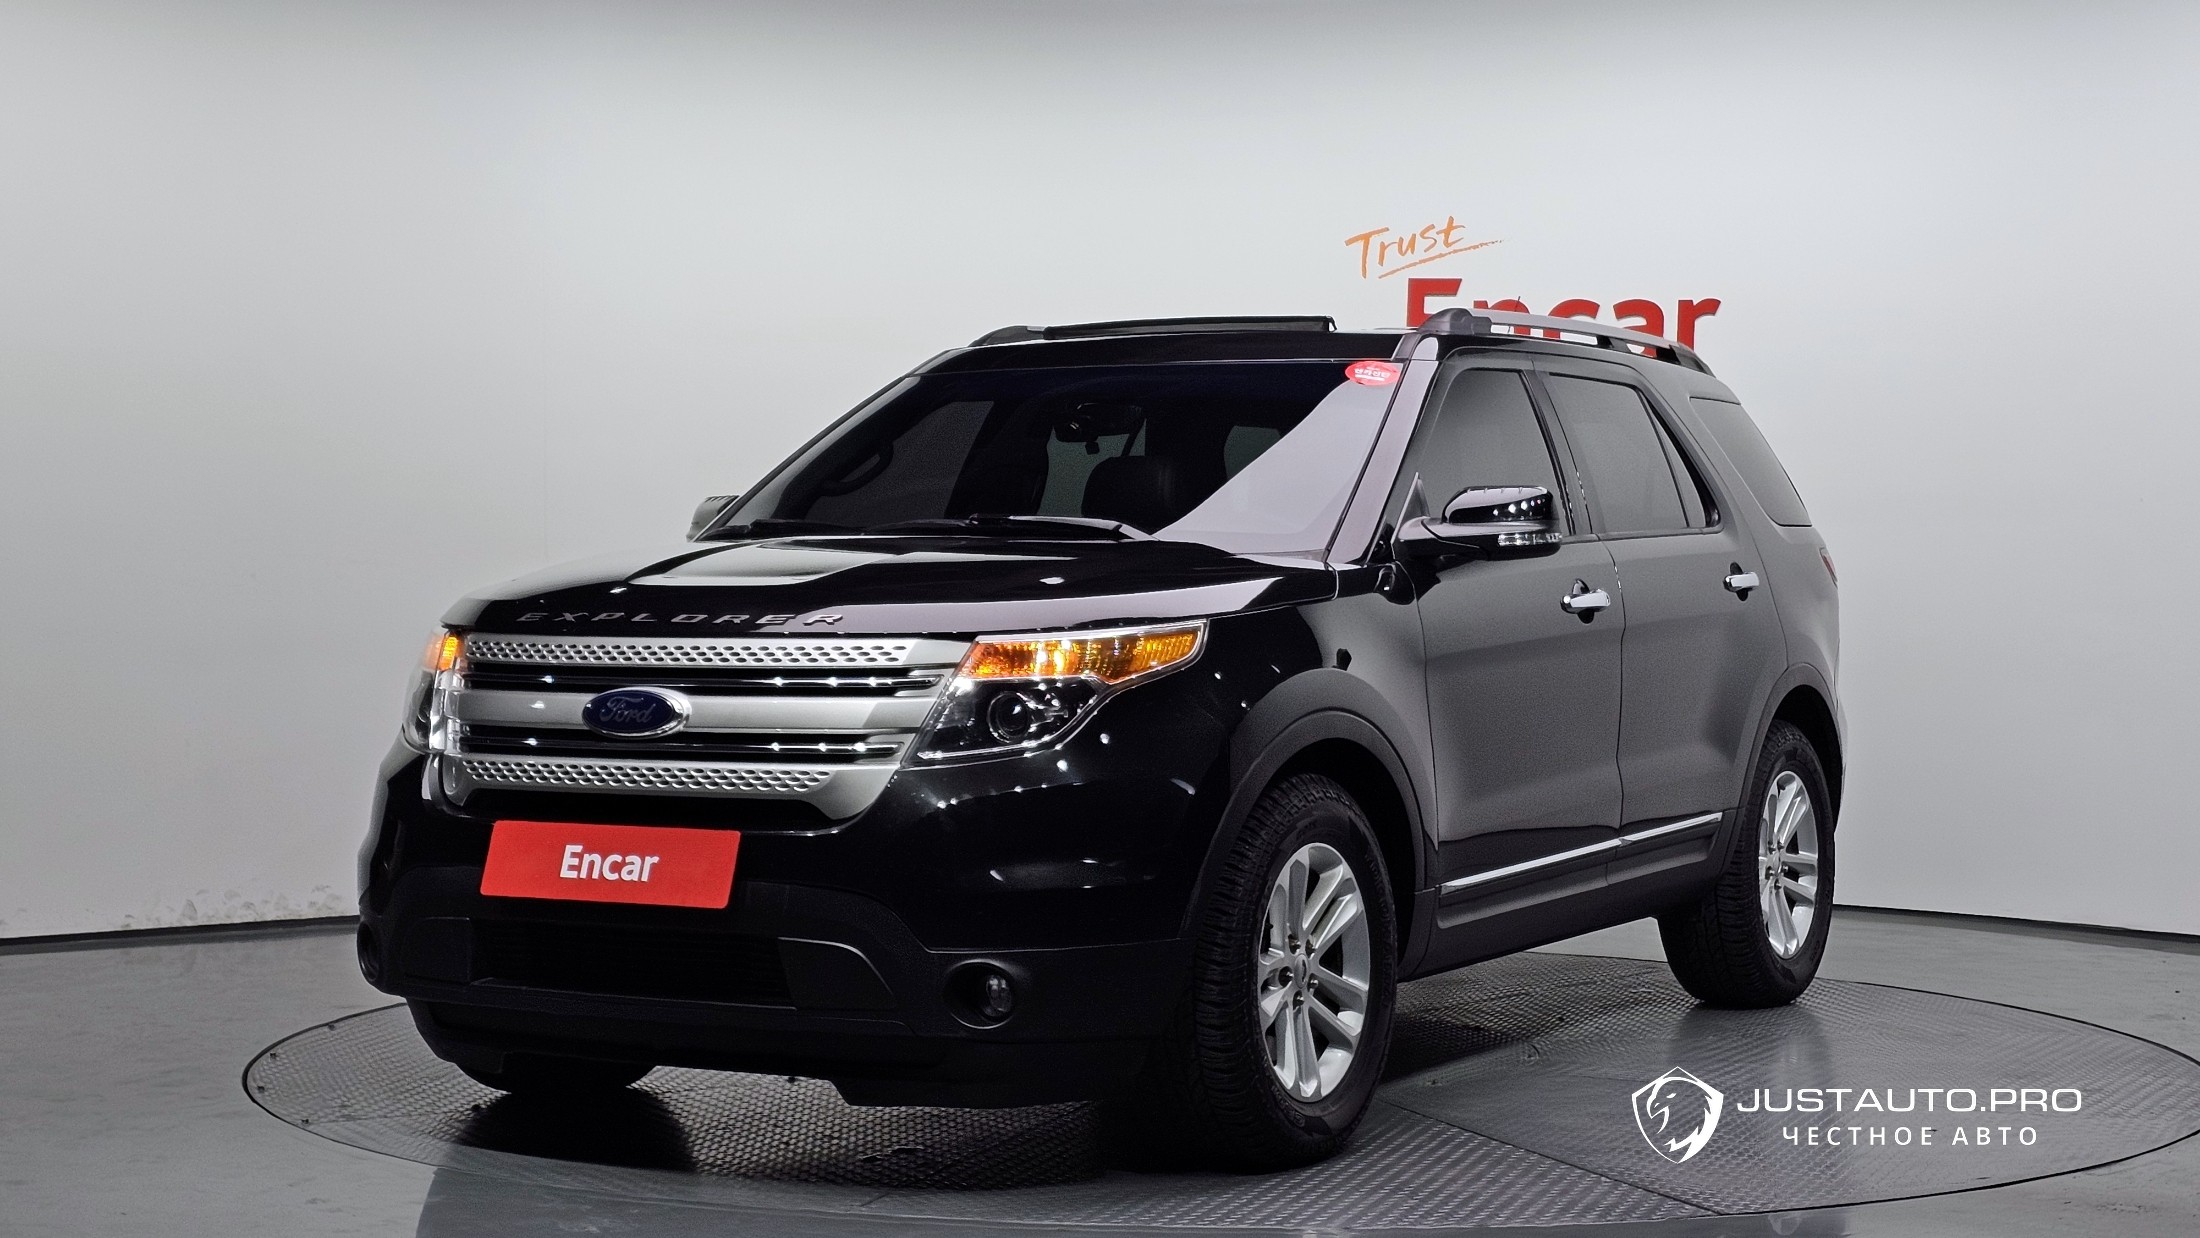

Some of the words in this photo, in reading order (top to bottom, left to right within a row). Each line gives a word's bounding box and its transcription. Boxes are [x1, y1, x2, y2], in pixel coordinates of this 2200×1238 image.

[1344, 215, 1467, 279] Trust
[515, 611, 844, 627] EXPLORER
[598, 695, 657, 724] Ford
[559, 844, 660, 882] Encar
